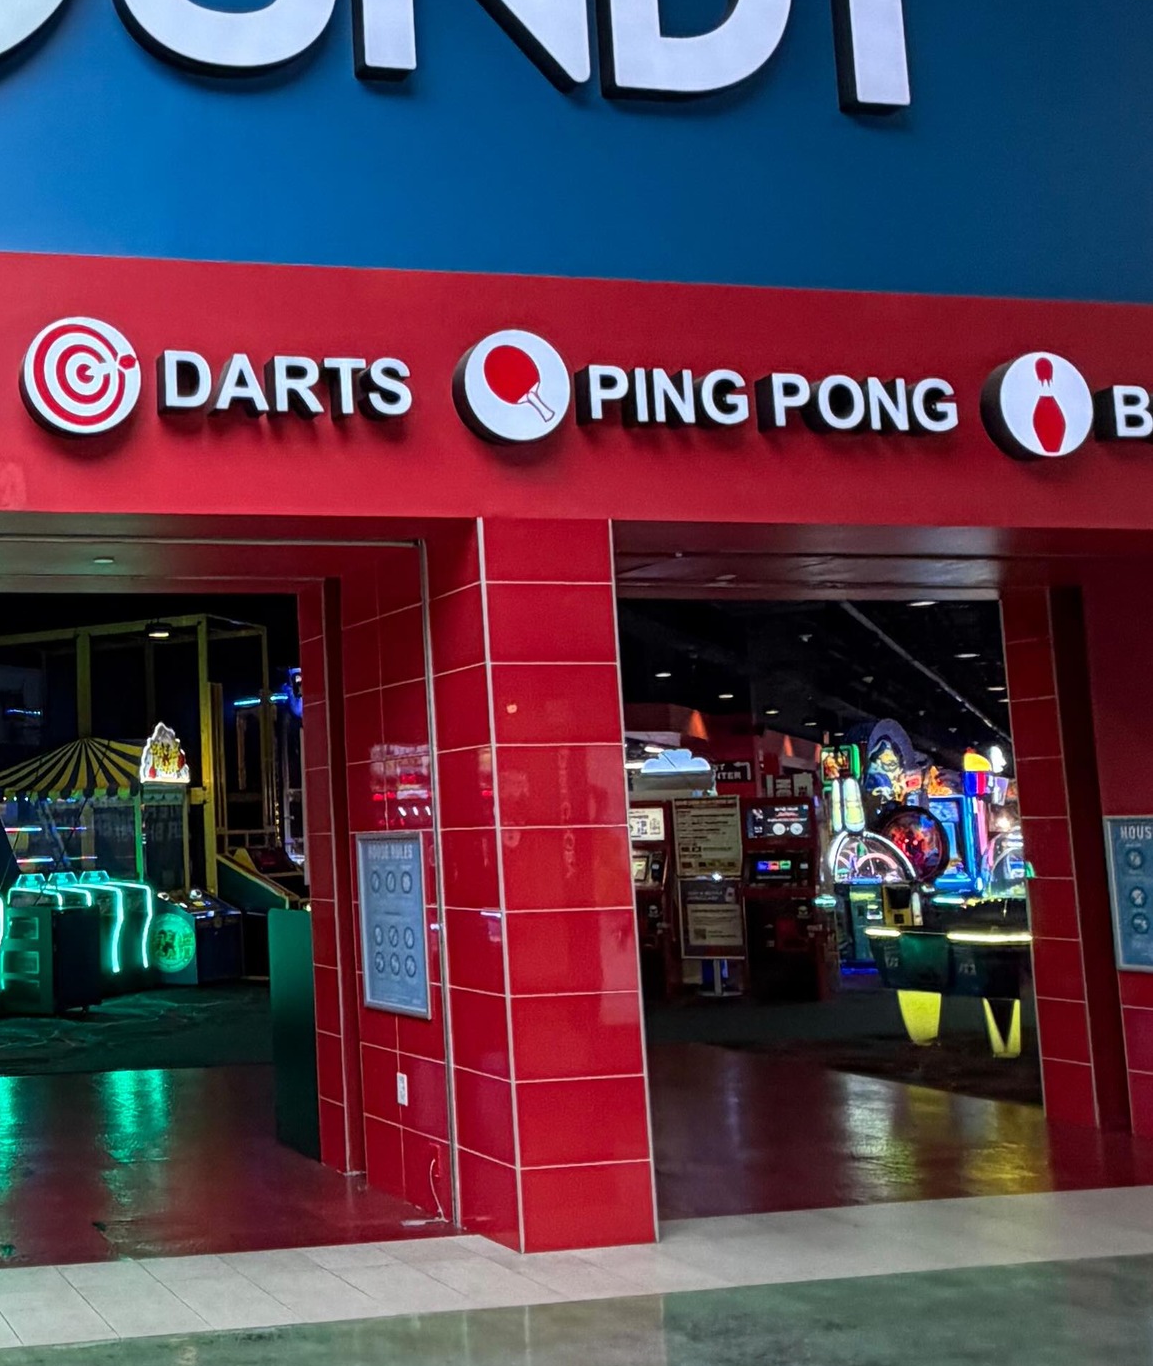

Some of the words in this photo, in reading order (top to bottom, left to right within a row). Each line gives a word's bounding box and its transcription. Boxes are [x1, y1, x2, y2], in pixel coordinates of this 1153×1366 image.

[162, 349, 413, 416] DARTS
[588, 364, 750, 426] PING
[771, 372, 959, 433] PONG
